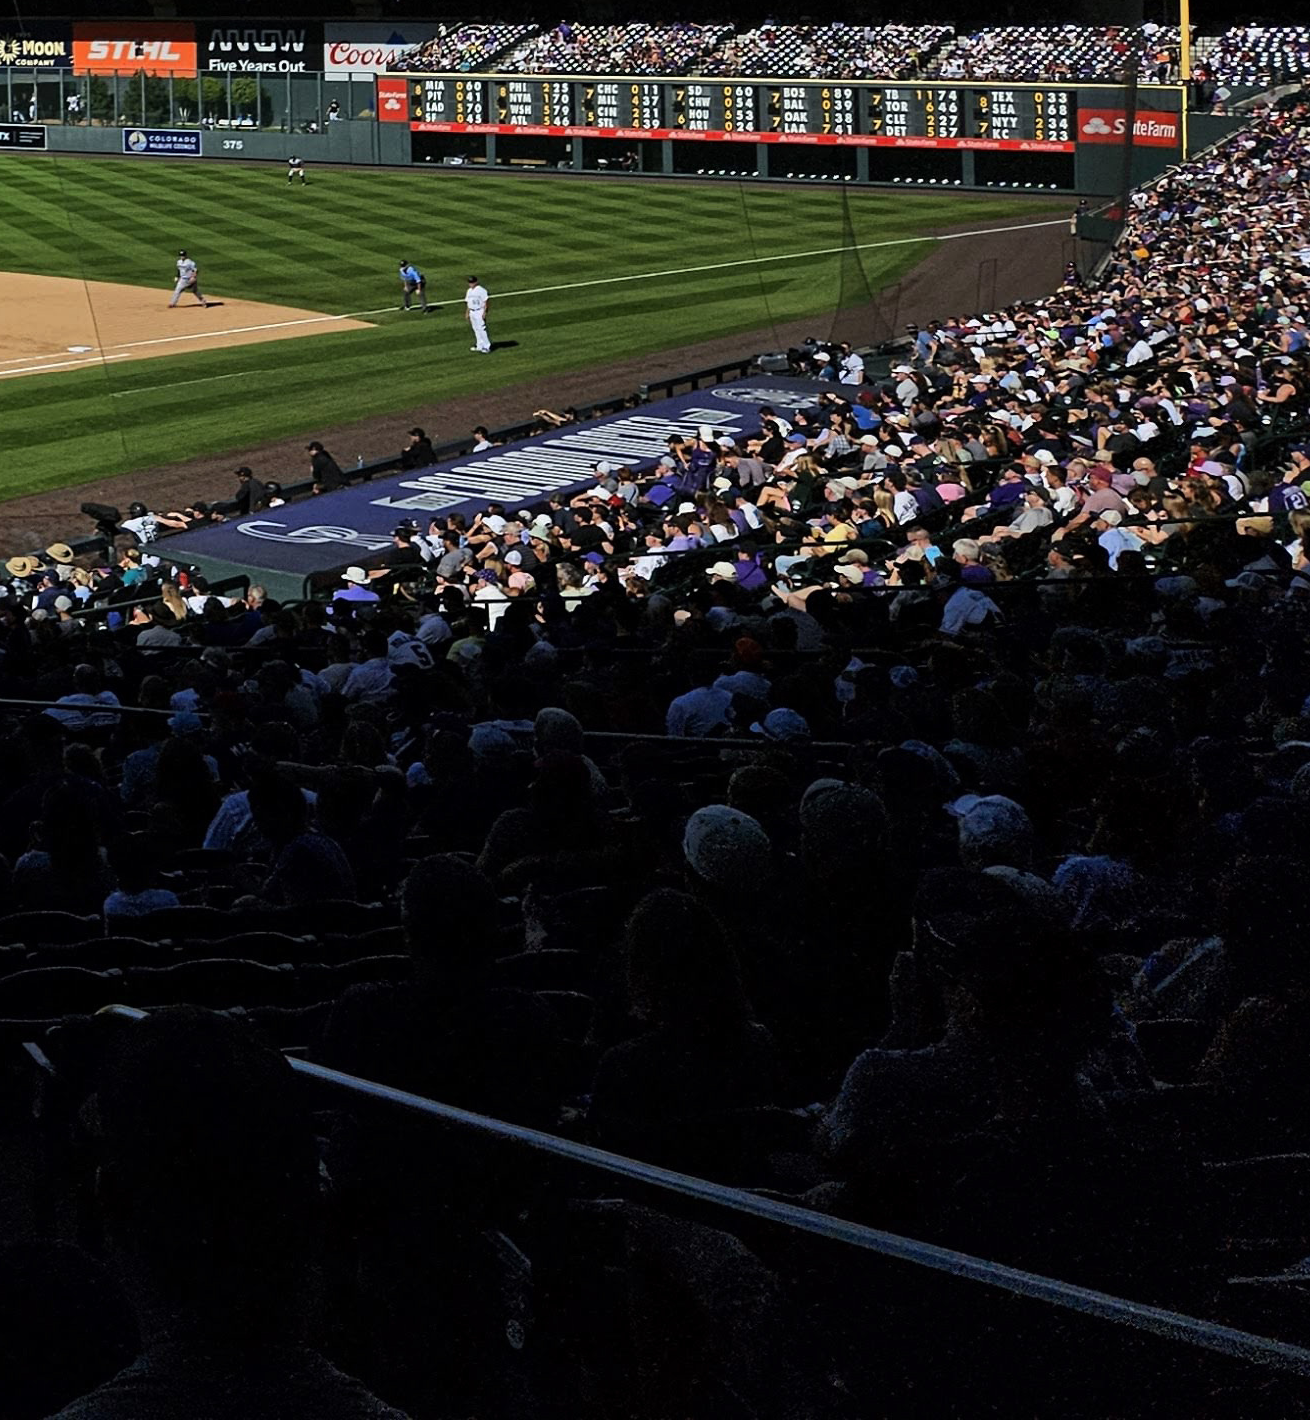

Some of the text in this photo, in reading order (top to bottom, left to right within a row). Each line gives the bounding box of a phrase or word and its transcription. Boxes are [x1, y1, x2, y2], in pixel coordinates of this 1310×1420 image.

[208, 29, 307, 53] ARROW
[22, 40, 67, 56] MOON
[330, 42, 401, 66] Coors
[14, 58, 55, 67] COMPANY
[209, 59, 306, 71] Five Years Out
[425, 80, 445, 91] MIA
[455, 81, 464, 92] 0
[510, 82, 527, 93] PHI
[543, 83, 551, 94] 2
[597, 84, 619, 95] CHC
[688, 85, 702, 96] SD
[427, 91, 442, 102] PIT
[455, 91, 464, 102] 0
[509, 93, 532, 104] NYM
[783, 87, 806, 99] BOS
[885, 90, 900, 101] TB
[992, 91, 1014, 103] TEX
[597, 95, 617, 106] MIL
[688, 97, 712, 108] CHW
[783, 99, 806, 110] BAL
[426, 102, 445, 113] LAD
[455, 103, 464, 113] 5
[510, 104, 532, 115] WSH
[597, 106, 618, 118] CIN
[885, 101, 908, 113] TOR
[992, 103, 1016, 115] SEA
[425, 112, 438, 123] SF
[455, 114, 464, 124] 0
[689, 108, 710, 120] HOU
[784, 111, 809, 123] OAK
[885, 114, 906, 125] CLE
[510, 115, 529, 126] ATL
[597, 118, 616, 129] STL
[689, 120, 709, 131] ARI
[992, 116, 1018, 128] NYY
[784, 123, 807, 134] LAA
[886, 126, 907, 138] DET
[993, 128, 1010, 140] KC
[149, 135, 197, 144] COLORADO
[223, 140, 244, 149] 375
